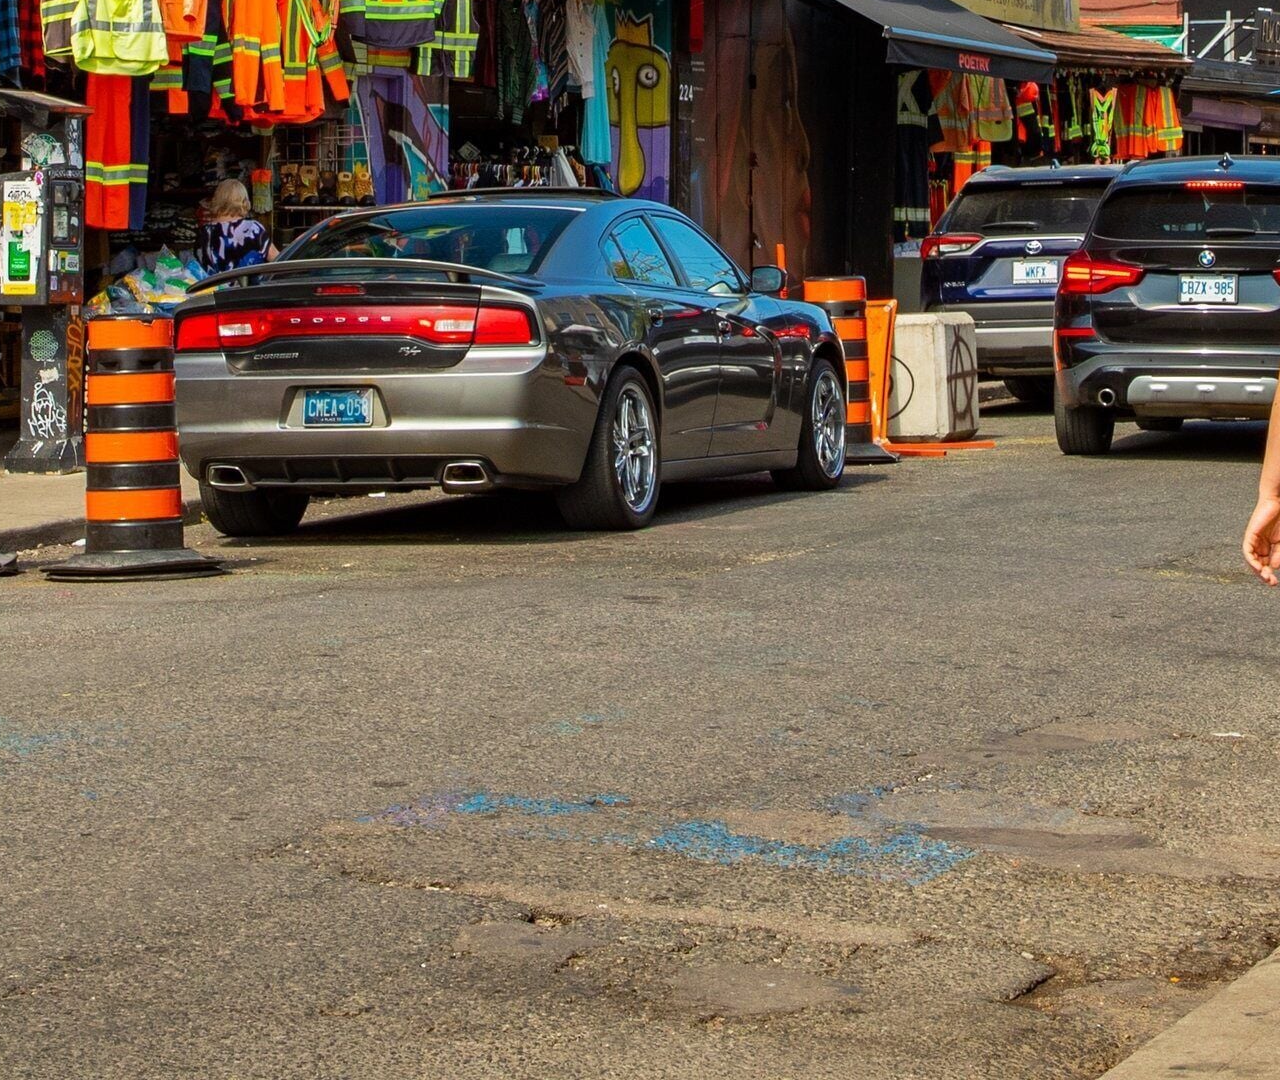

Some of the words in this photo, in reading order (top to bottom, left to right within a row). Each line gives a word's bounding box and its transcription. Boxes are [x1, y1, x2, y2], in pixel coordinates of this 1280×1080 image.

[959, 53, 990, 71] POETRY
[679, 84, 693, 101] 224
[1025, 266, 1046, 278] WKFX
[1180, 281, 1207, 295] CBZX
[1214, 281, 1234, 295] 985
[308, 399, 338, 417] CMEA
[346, 399, 369, 417] 058
